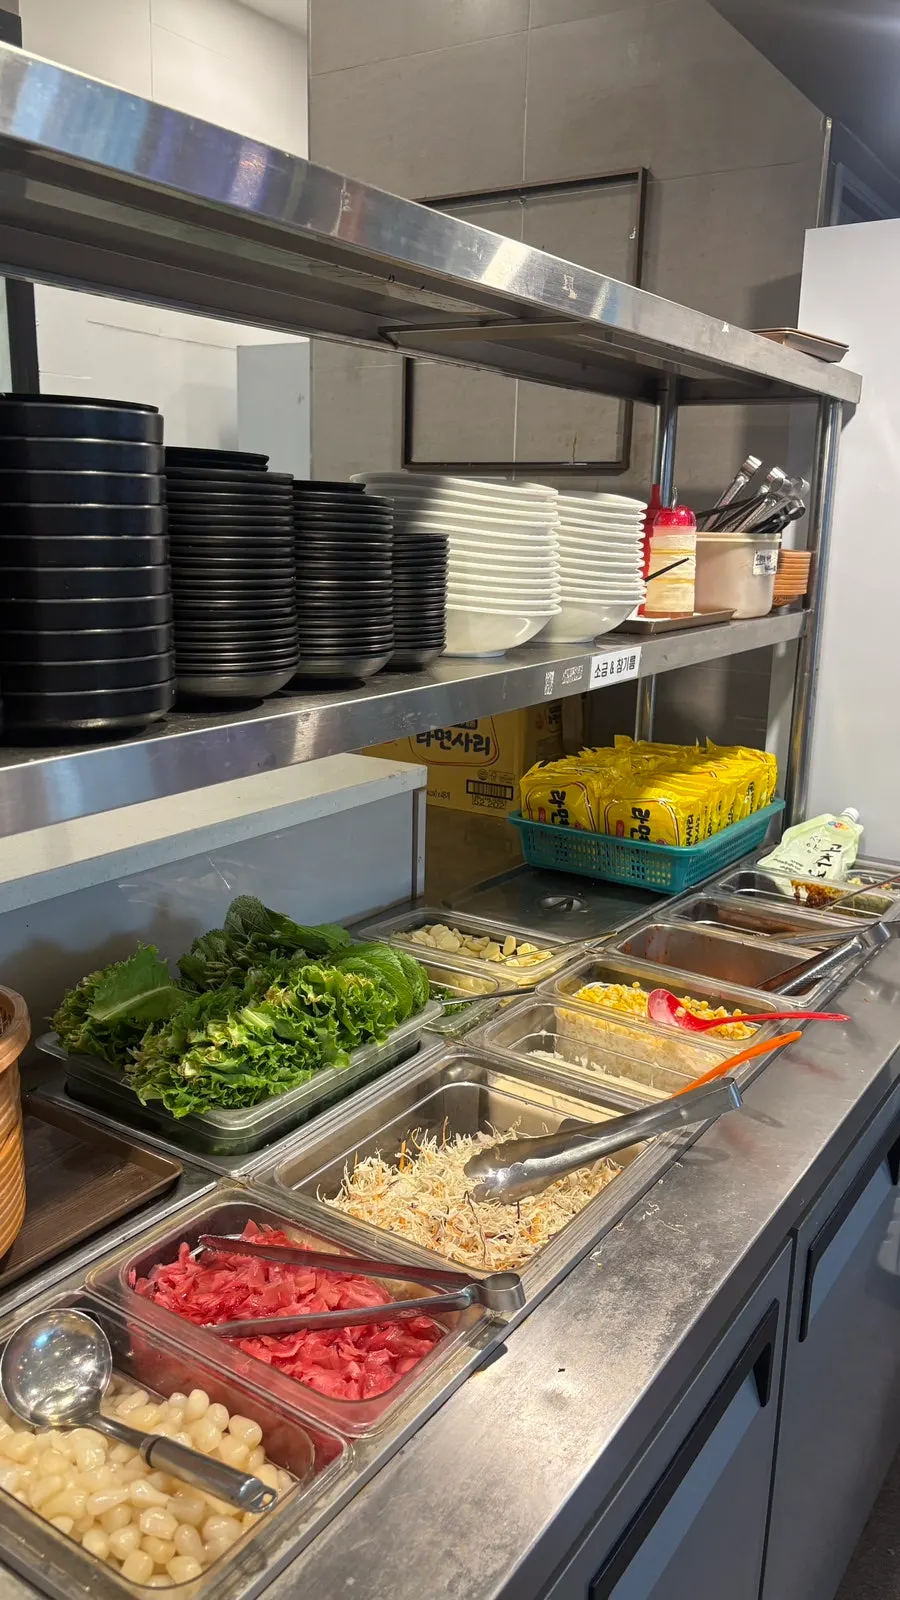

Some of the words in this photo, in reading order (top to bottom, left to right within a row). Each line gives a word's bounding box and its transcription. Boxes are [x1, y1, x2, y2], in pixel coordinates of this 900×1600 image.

[594, 662, 608, 679] 소금
[610, 661, 614, 674] &
[616, 655, 636, 674] 참기름
